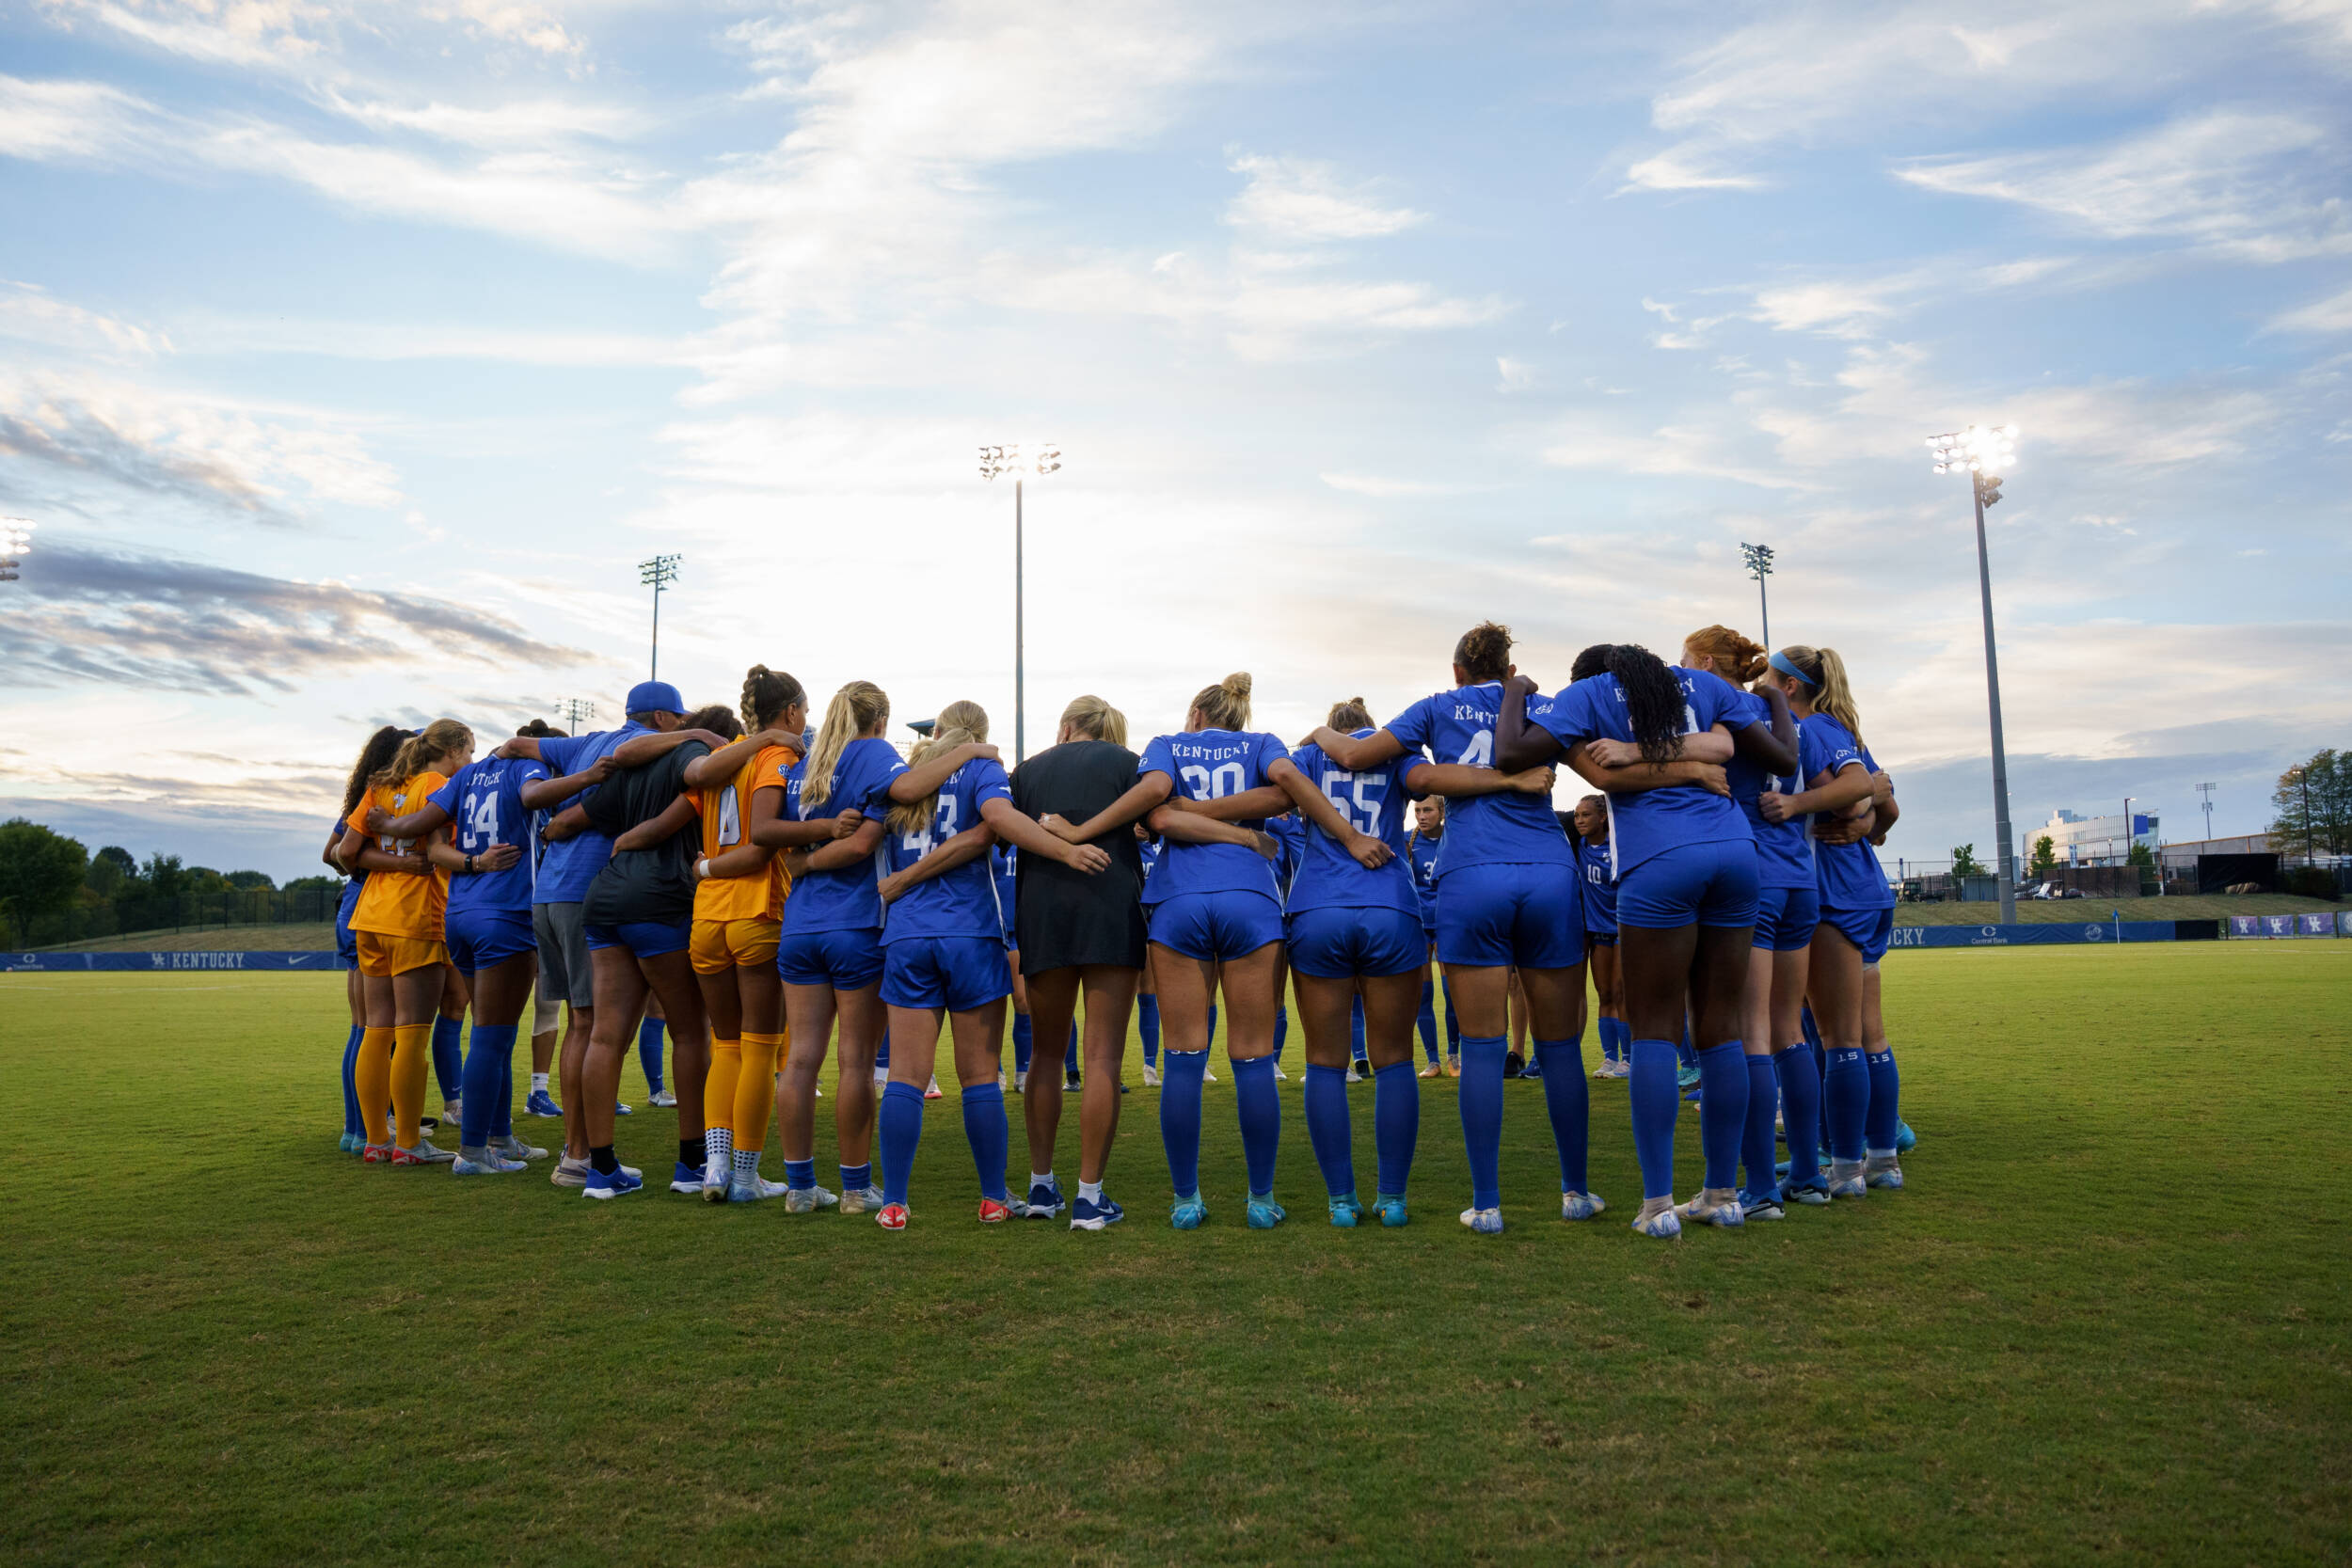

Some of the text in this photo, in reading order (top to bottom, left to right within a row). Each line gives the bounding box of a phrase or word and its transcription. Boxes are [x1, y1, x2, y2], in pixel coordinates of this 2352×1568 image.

[1172, 741, 1249, 760] KENTUCKY
[463, 791, 499, 848] 34
[1587, 863, 1601, 884] 10
[172, 952, 245, 968] KENTUCKY
[1836, 1051, 1859, 1063] 15
[1870, 1053, 1890, 1064] 15
